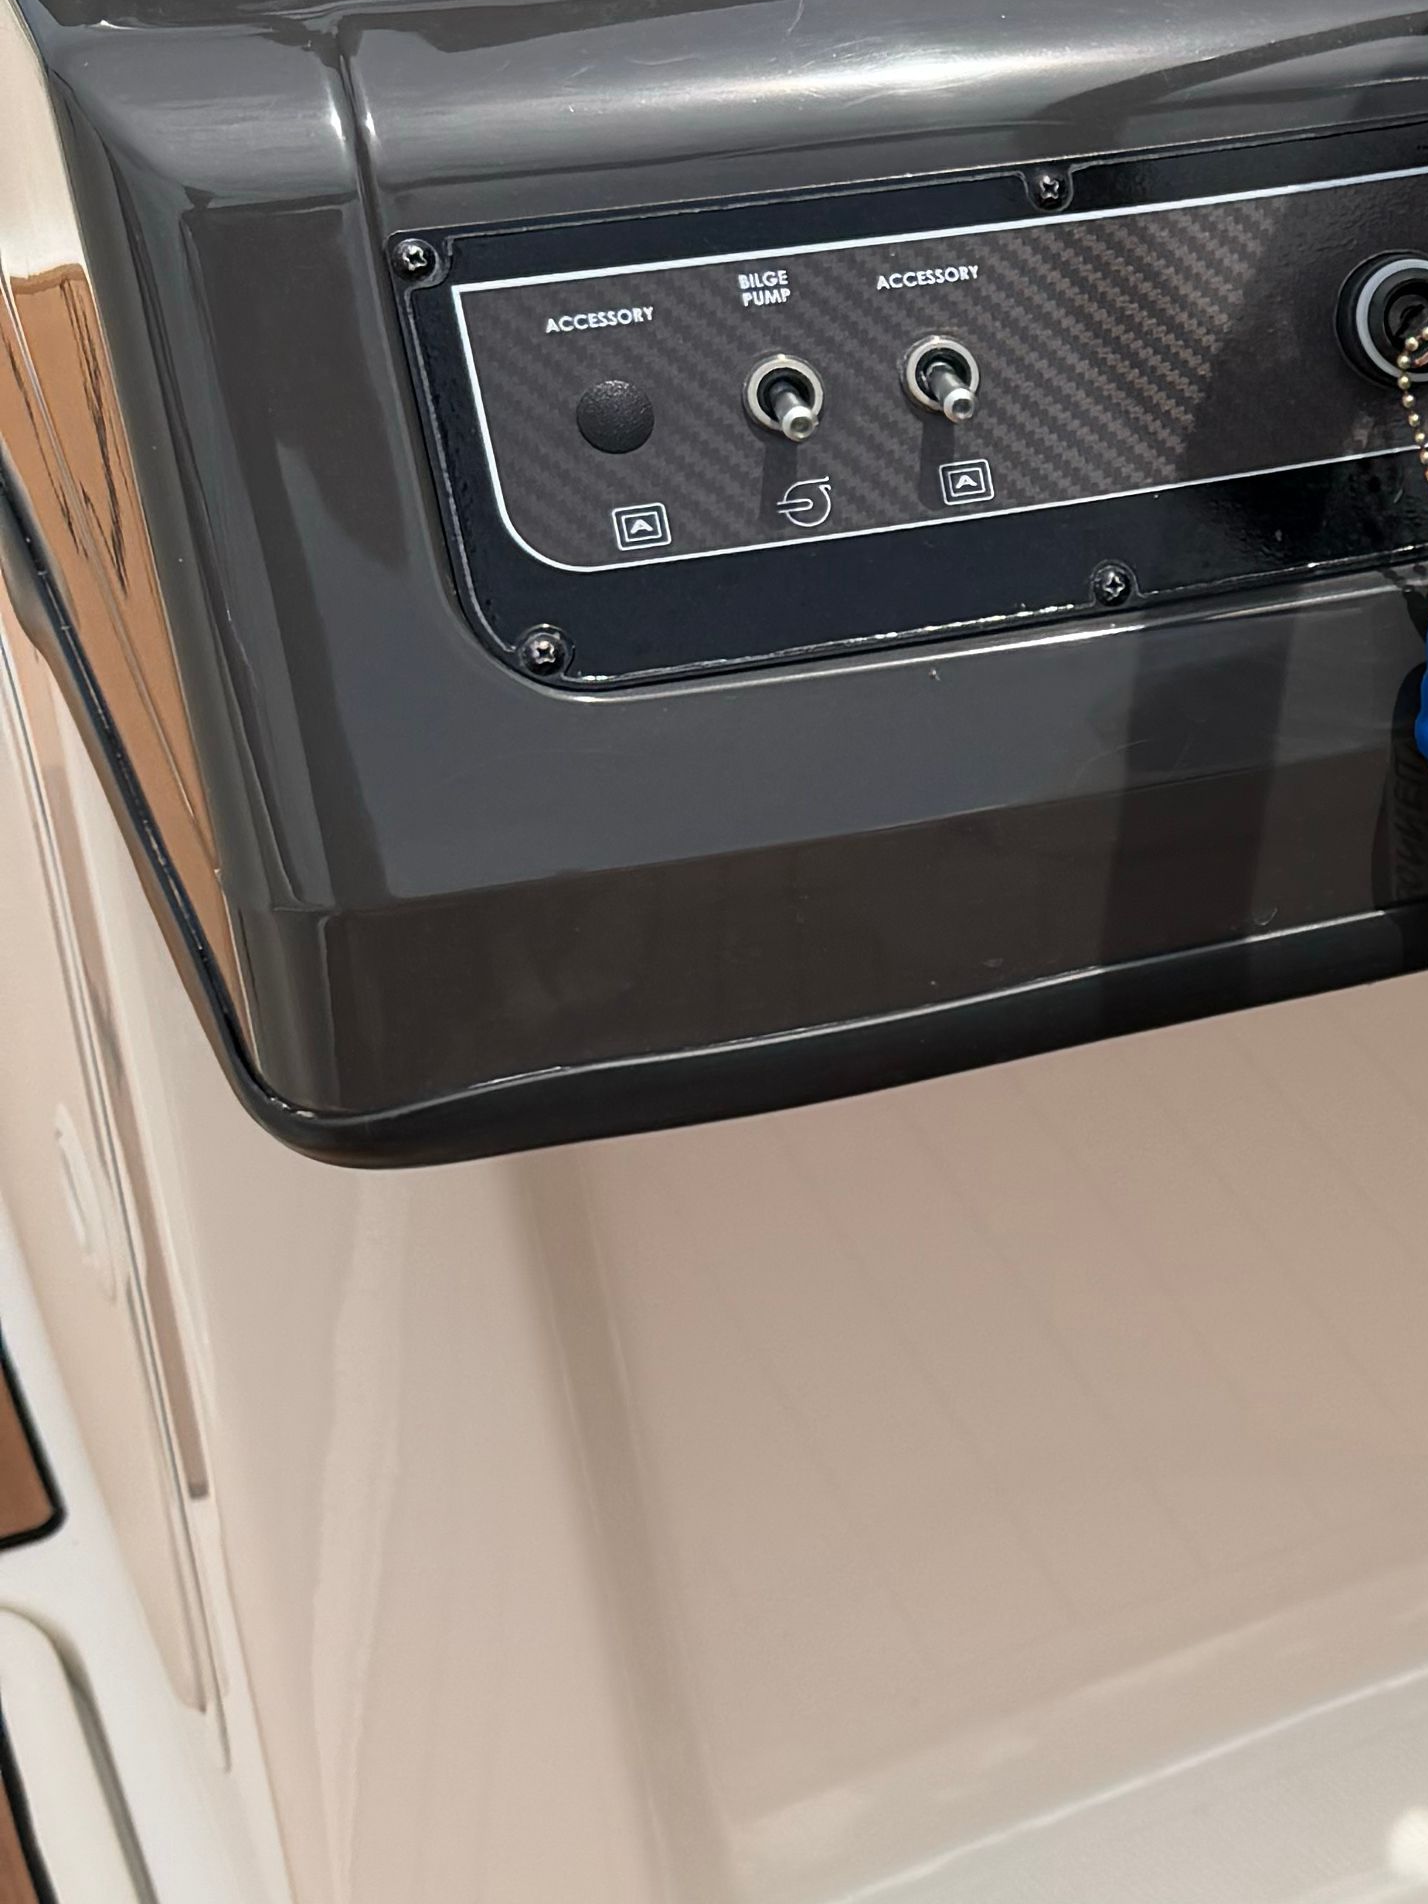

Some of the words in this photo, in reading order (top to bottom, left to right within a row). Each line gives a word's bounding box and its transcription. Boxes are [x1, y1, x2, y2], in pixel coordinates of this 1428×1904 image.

[738, 270, 789, 290] BILGE
[876, 265, 981, 291] ACCESSORY
[742, 287, 791, 307] PUMP
[545, 306, 655, 334] ACCESSORY
